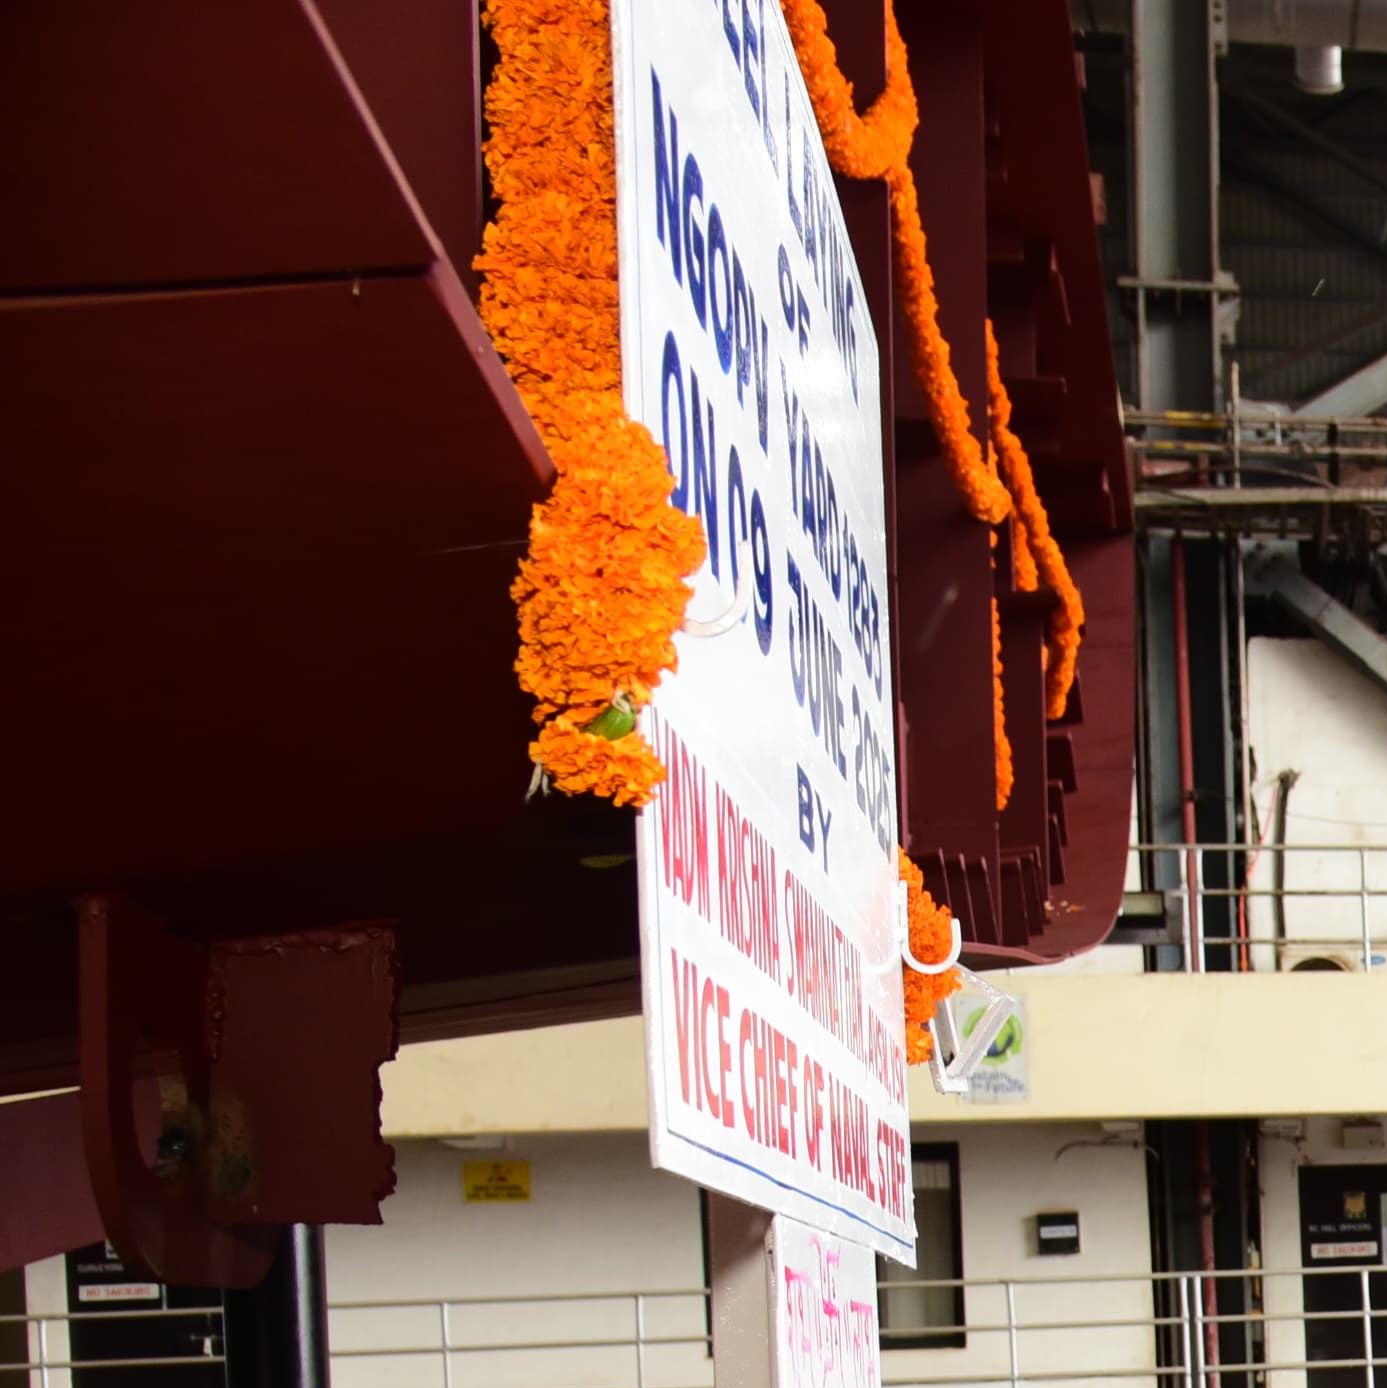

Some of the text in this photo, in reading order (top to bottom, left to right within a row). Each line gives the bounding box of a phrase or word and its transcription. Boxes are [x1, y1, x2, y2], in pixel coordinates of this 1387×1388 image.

[778, 243, 811, 359] OF
[785, 67, 858, 411] LAYING
[650, 62, 884, 702] NGOPV YARD 1283
[662, 331, 721, 585] ON
[786, 547, 848, 782] JUNE
[852, 683, 892, 865] 2025
[654, 706, 711, 924] VADM
[715, 779, 781, 986] KRISHNA
[796, 761, 833, 876] BY
[670, 945, 907, 1225] VICE CHIEF OF NAVAL STAFF
